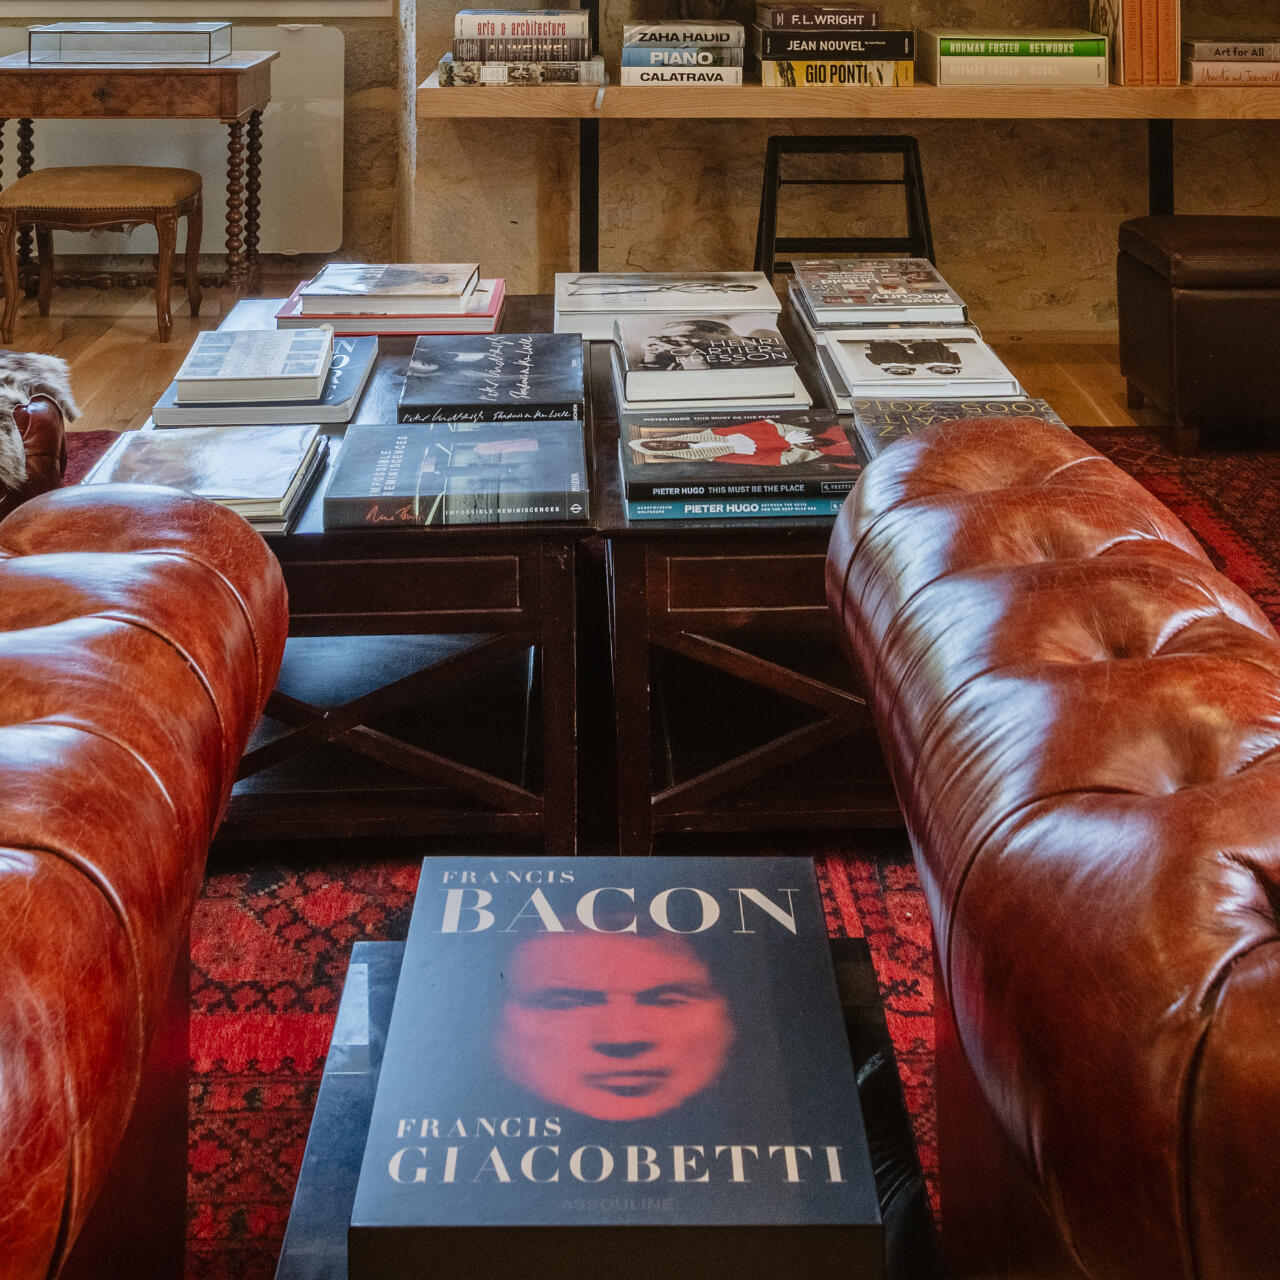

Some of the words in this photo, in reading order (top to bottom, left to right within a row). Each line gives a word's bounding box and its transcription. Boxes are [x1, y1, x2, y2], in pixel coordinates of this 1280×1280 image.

[477, 21, 495, 36] arts
[511, 21, 566, 36] architecture
[638, 32, 681, 42] ZAHA
[683, 32, 730, 42] HADID
[787, 40, 817, 51] JEAN
[820, 40, 865, 51] NOUVEL
[950, 42, 986, 53] NORMAN
[988, 42, 1020, 53] FOSTER
[1029, 43, 1074, 53] NETWORKS
[650, 51, 713, 65] PIANO
[1214, 47, 1232, 57] Art
[1233, 47, 1249, 57] for
[1250, 47, 1265, 57] All
[640, 72, 724, 82] CALATRAVA
[805, 64, 827, 84] GIO
[830, 64, 868, 84] PONTI
[710, 337, 780, 347] HENRI
[670, 346, 783, 356] CARTIER-
[382, 435, 408, 496] REMINISCENCES
[652, 487, 680, 496] PIETER
[681, 486, 705, 495] HUGO
[708, 486, 727, 494] THIS
[728, 486, 750, 494] MUST
[751, 485, 763, 493] BE
[764, 485, 779, 493] THE
[780, 484, 805, 492] PLACE
[446, 508, 493, 516] IMPOSSIBLE
[497, 506, 560, 514] REMINISCENCES
[684, 505, 724, 515] PIETER
[726, 503, 759, 513] HUGO
[441, 869, 576, 884] FRANCIS
[432, 886, 801, 935] BACON
[395, 1115, 563, 1139] FRANCIS
[387, 1144, 849, 1183] GIACOBETTI
